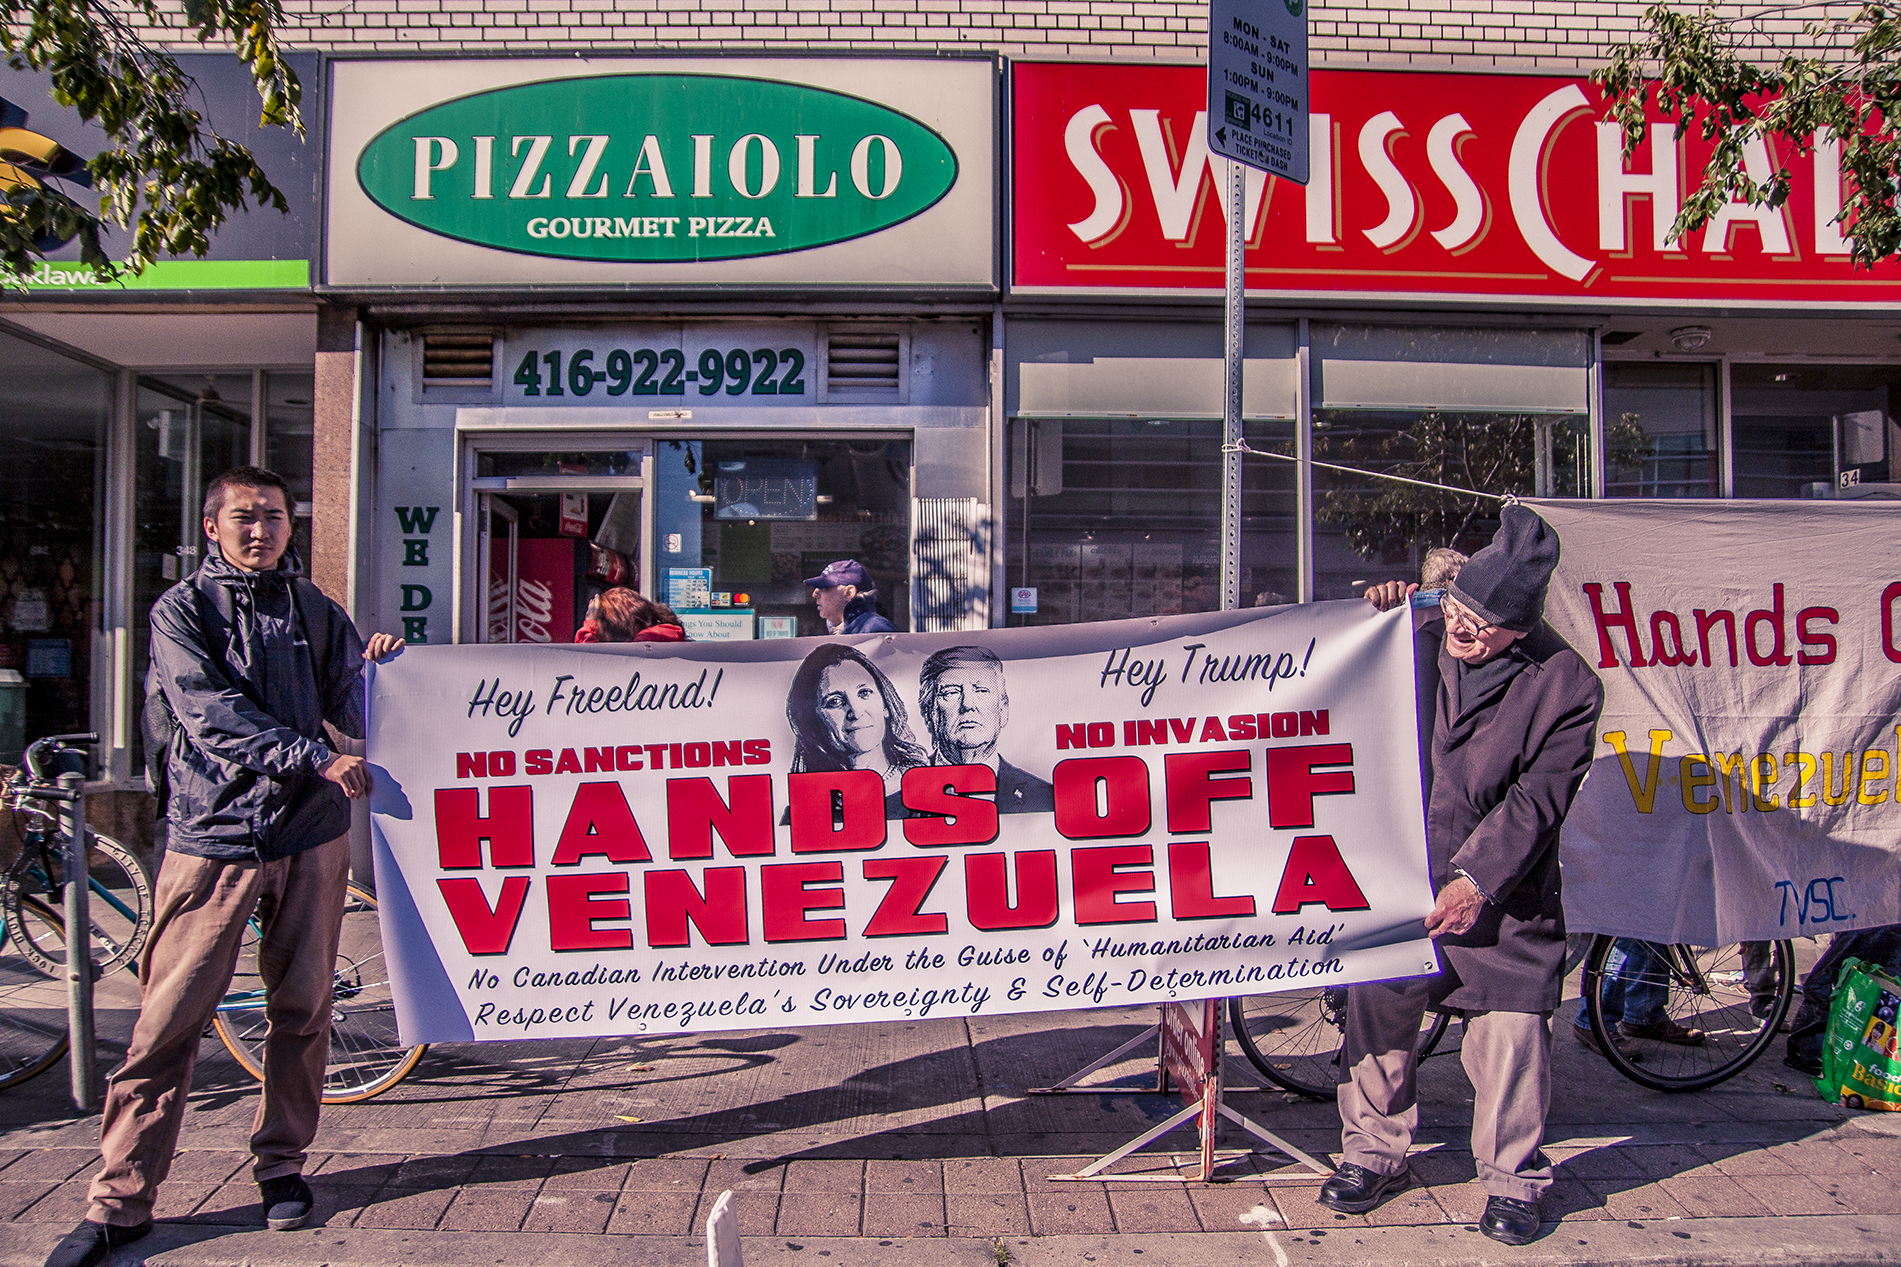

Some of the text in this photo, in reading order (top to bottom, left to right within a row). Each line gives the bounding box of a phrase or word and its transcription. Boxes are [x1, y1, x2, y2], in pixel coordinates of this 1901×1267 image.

[1223, 31, 1259, 58] 8:00AM
[1266, 51, 1299, 77] 9:00PM
[1233, 16, 1260, 40] MON
[1270, 35, 1291, 54] SAT
[1223, 68, 1259, 94] 1:00PM
[1266, 87, 1299, 112] 9:00PM
[1251, 61, 1275, 83] SUN
[1251, 103, 1293, 137] 4611
[1231, 129, 1292, 161] PLACE PURCHASED
[1235, 142, 1258, 160] TICKET
[1270, 156, 1289, 171] DASH
[410, 132, 904, 200] PIZZAIOLO
[526, 216, 777, 239] GOURMET PIZZA
[513, 347, 805, 396] 416-922-9922
[724, 477, 805, 505] OPEN
[1841, 471, 1858, 487] 34
[176, 546, 198, 556] 348
[698, 620, 713, 628] You
[715, 619, 742, 628] Should
[707, 630, 730, 638] About
[1583, 581, 1840, 668] Hands
[1100, 637, 1316, 707] Hey Trump!
[467, 667, 724, 738] Hey Freeland!
[1056, 711, 1330, 750] NO INVASION
[457, 739, 772, 778] NO SANCTIONS
[434, 743, 1355, 869] HANDS OFF
[436, 835, 1369, 956] VENEZUELA
[467, 967, 500, 990] No
[512, 963, 641, 988] Canadian
[652, 957, 806, 983] Intervention
[816, 951, 895, 976] Under
[905, 947, 945, 969] the
[957, 944, 1031, 967] Guise
[1041, 939, 1068, 970] of
[474, 957, 1345, 1032] Respect Venezuela's Sovereignty & Self-Determination
